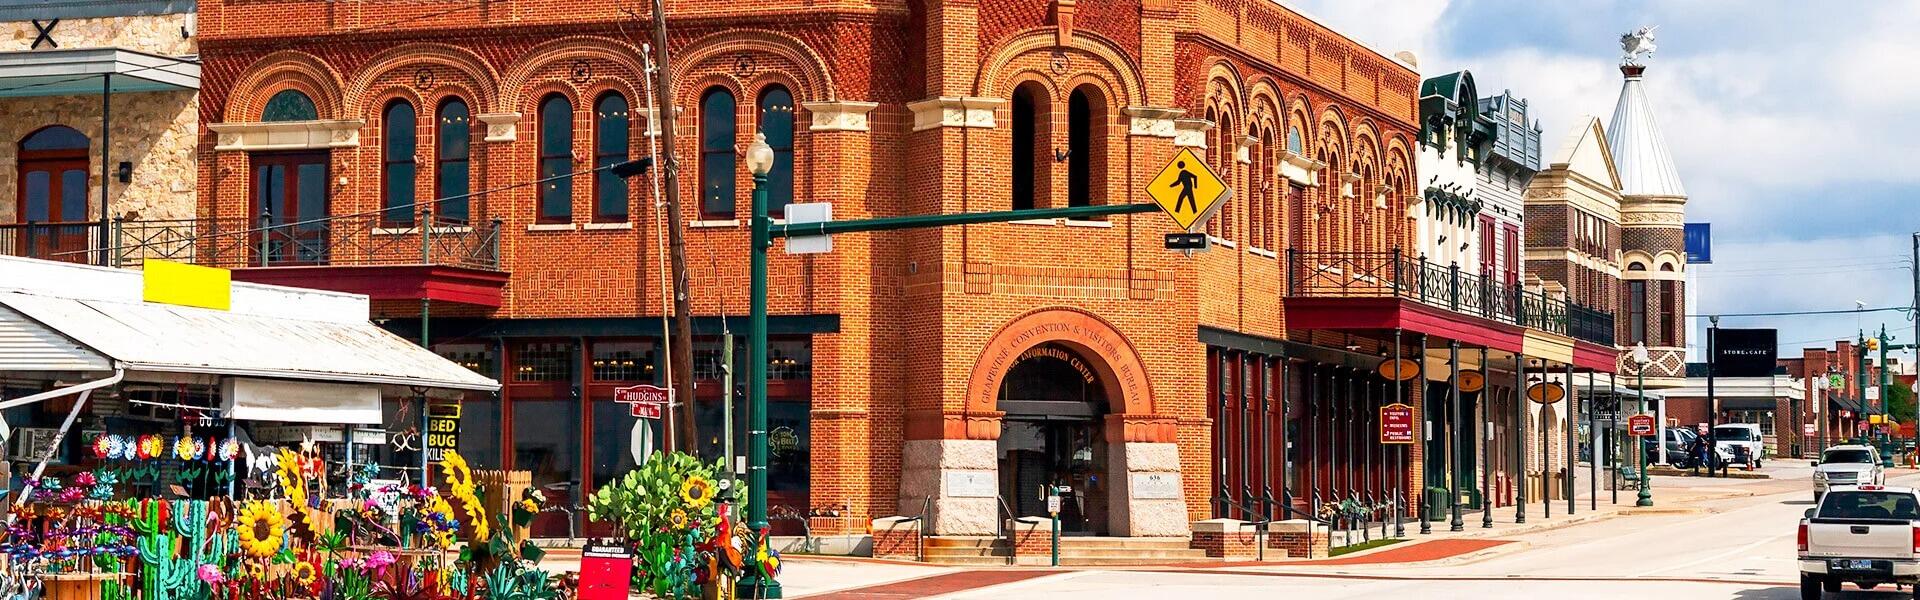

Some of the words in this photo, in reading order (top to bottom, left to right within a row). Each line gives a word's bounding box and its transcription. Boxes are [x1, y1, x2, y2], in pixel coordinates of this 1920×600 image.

[981, 346, 1009, 404] GRAPEVINE
[1010, 323, 1070, 348] CONVENTION
[1073, 325, 1081, 335] &
[1083, 328, 1122, 361] VISITORS
[1120, 364, 1140, 405] BUREAU
[1020, 347, 1069, 361] INFORMATION
[1070, 357, 1095, 384] CENTER
[627, 392, 663, 401] HUDGINS
[430, 419, 456, 432] BED
[428, 434, 456, 447] BUG
[591, 546, 625, 554] GUARANTEED
